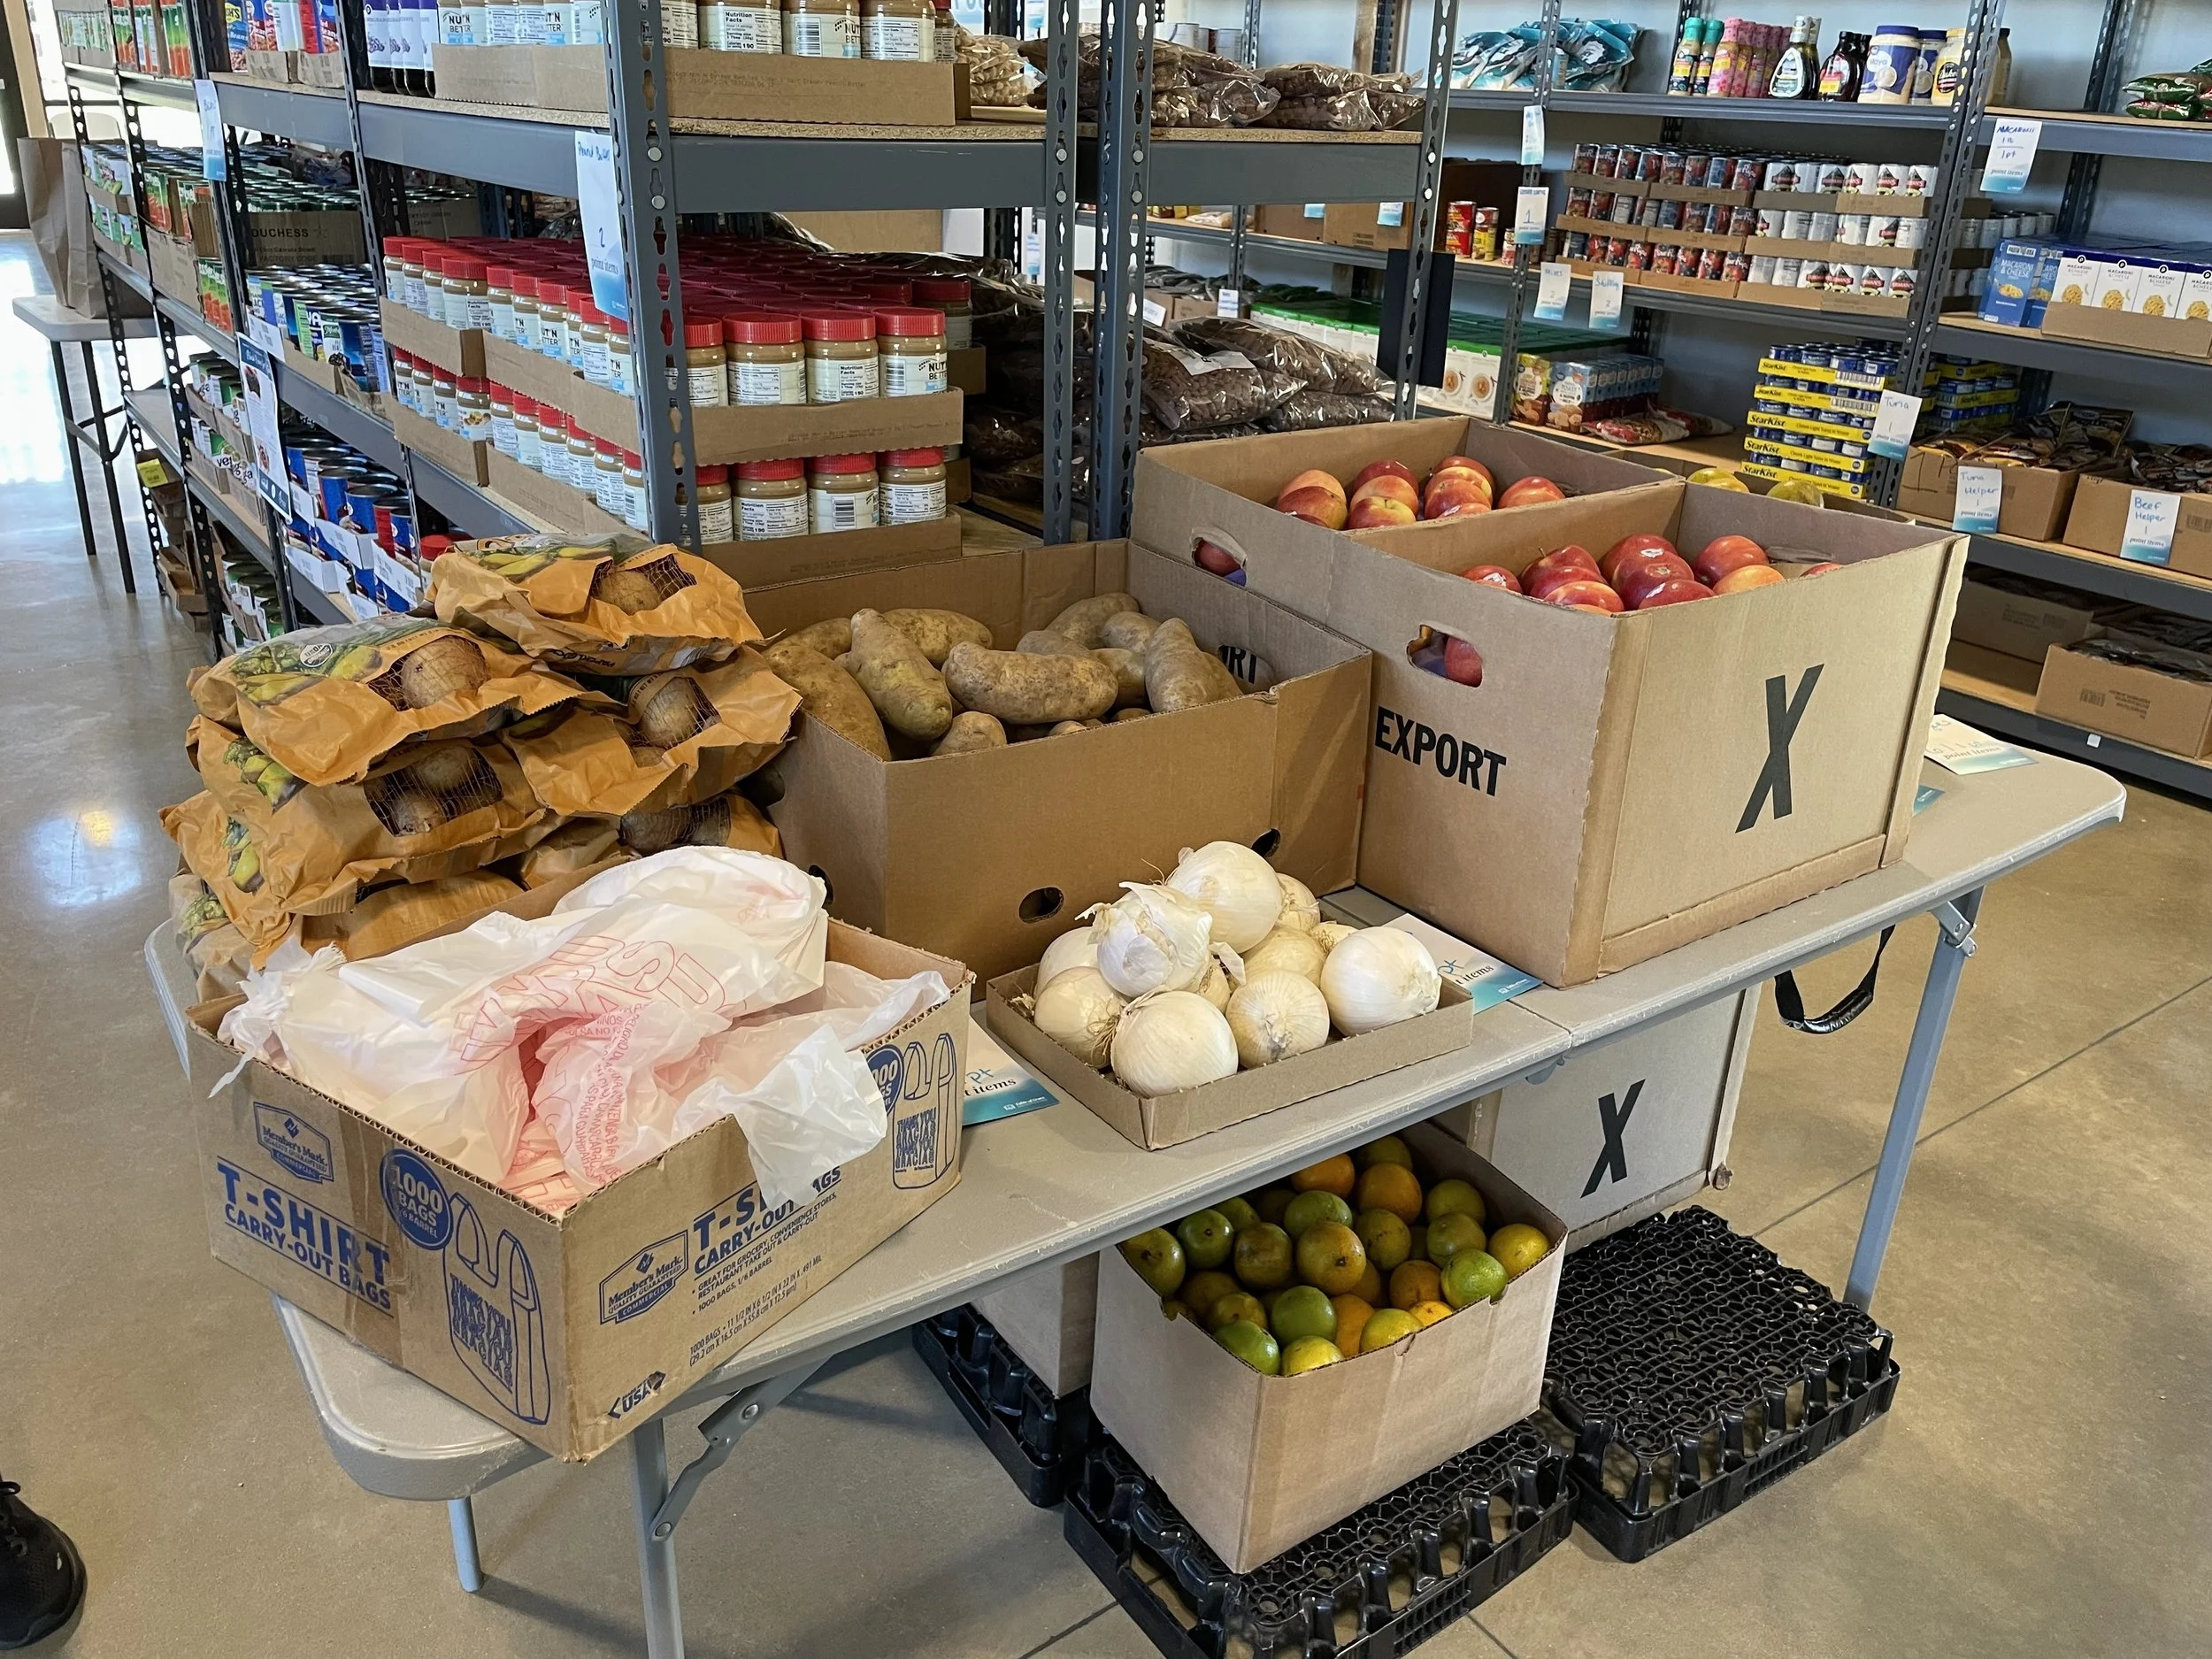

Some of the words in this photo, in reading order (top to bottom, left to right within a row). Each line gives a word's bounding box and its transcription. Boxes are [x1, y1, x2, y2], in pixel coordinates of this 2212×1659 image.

[2001, 259, 2034, 272] MACARONI
[2006, 268, 2030, 278] CHEESE
[1763, 362, 1786, 372] StarKist
[1885, 396, 1909, 409] Tuna
[1750, 413, 1786, 427] StarKist
[1746, 440, 1780, 455] StarKist
[1743, 465, 1778, 479] StarKist
[1964, 487, 1998, 497] Helper
[2134, 496, 2162, 511] Beef
[2135, 511, 2167, 523] Helper
[1374, 705, 1507, 797] EXPORT
[1735, 664, 1824, 833] X
[972, 1079, 1017, 1094] items
[1580, 1078, 1646, 1198] X
[216, 1162, 390, 1286] T-SHIRT
[398, 1190, 437, 1226] BAGS
[409, 1213, 438, 1239] BARREL
[698, 1270, 722, 1292] GREAT
[722, 1263, 736, 1275] FOR
[737, 1239, 769, 1265] GROCERY,
[770, 1210, 813, 1242] CONVENIENCE
[813, 1192, 837, 1212] STORES,
[225, 1202, 334, 1278] CARRY-OUT
[338, 1264, 391, 1310] BAGS
[698, 1267, 743, 1300] RESTAURANT
[744, 1254, 762, 1269] TAKE
[762, 1242, 777, 1256] OUT
[783, 1211, 819, 1241] CARRY-OUT
[608, 1294, 637, 1315] QUALITY
[638, 1264, 682, 1295] GUARANTEED
[608, 1273, 655, 1308] Member's
[622, 1282, 669, 1316] COMMERCIAL
[698, 1296, 716, 1312] 1000
[738, 1274, 749, 1286] 1/6
[749, 1256, 772, 1277] BARREL
[689, 1340, 705, 1356] 1000
[705, 1326, 721, 1344] BAGS
[622, 1379, 652, 1413] USA
